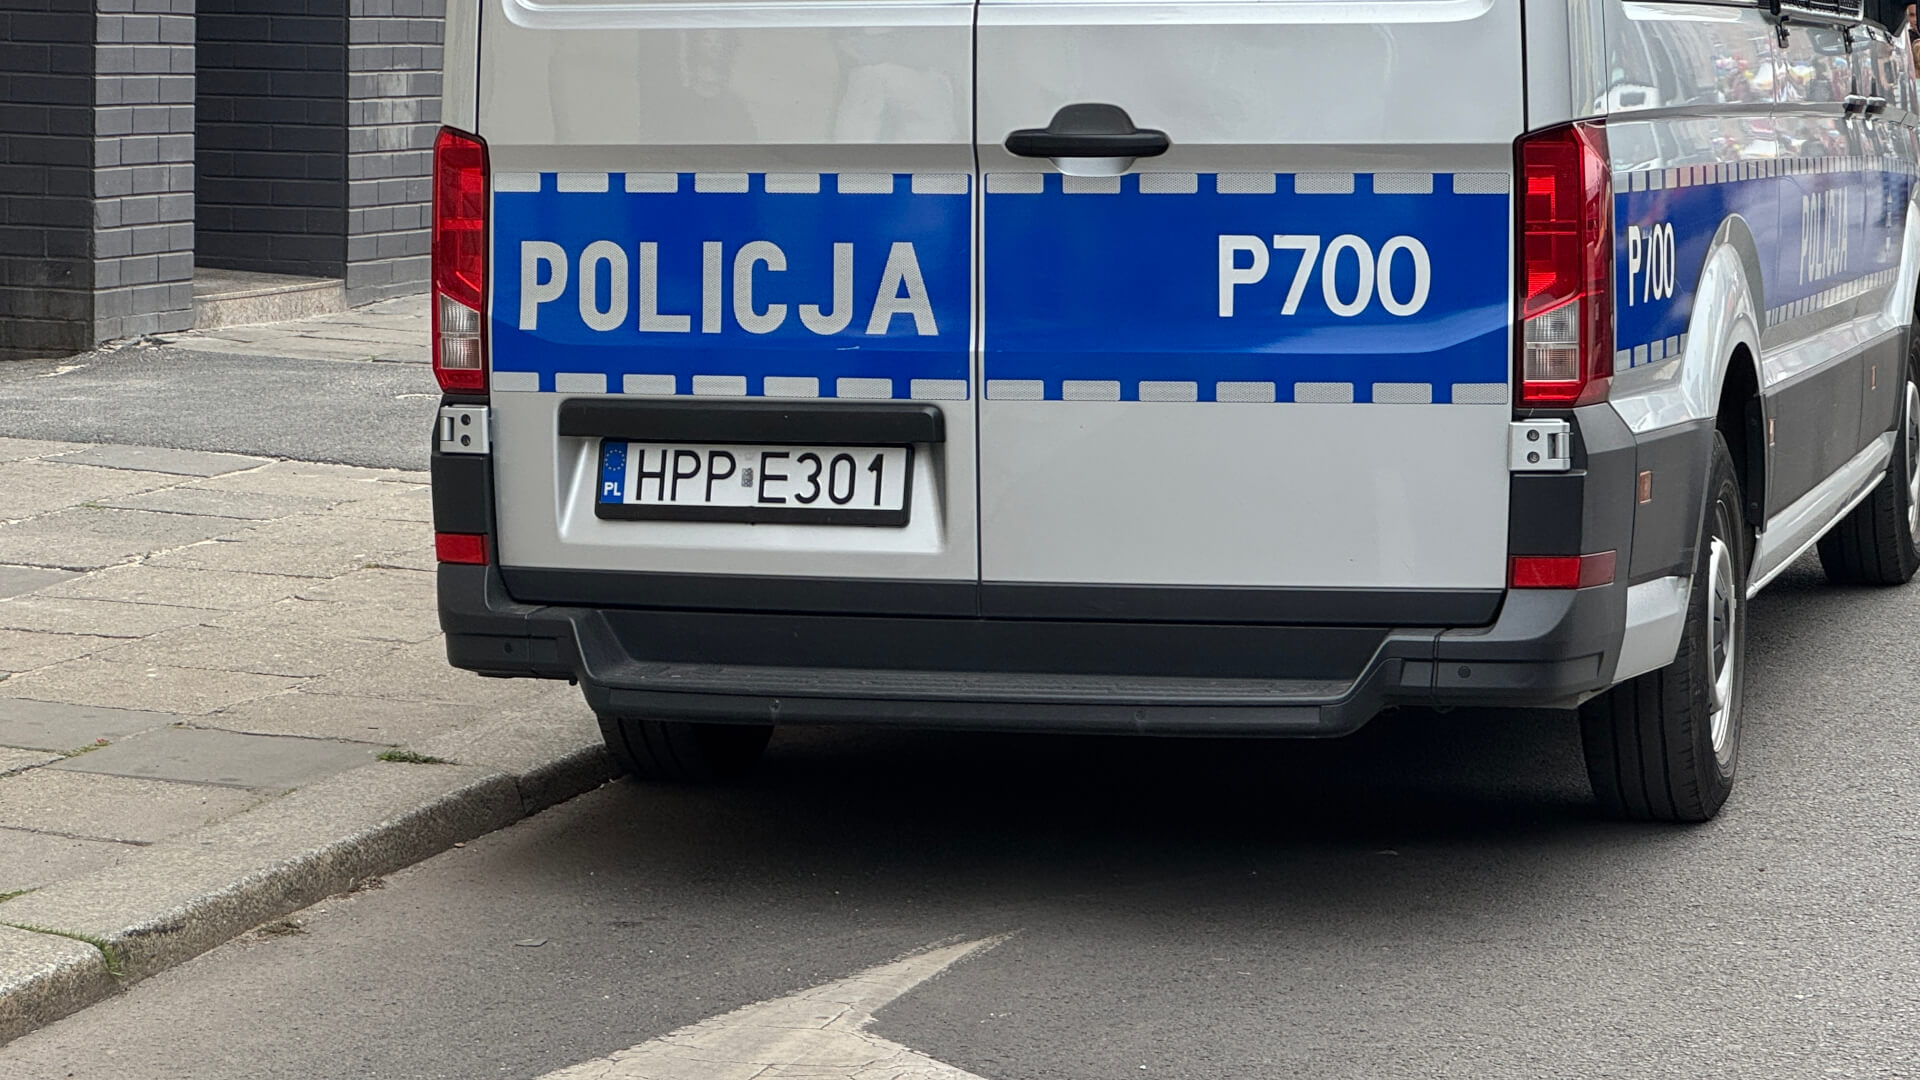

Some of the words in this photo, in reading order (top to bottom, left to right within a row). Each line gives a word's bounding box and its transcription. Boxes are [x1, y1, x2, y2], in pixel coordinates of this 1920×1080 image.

[1218, 234, 1431, 317] P700
[1628, 222, 1675, 307] P700
[1799, 186, 1848, 286] POLICJA
[519, 240, 939, 336] POLICJA
[603, 482, 622, 497] PL
[635, 449, 737, 502] HPP
[758, 451, 884, 506] E301
